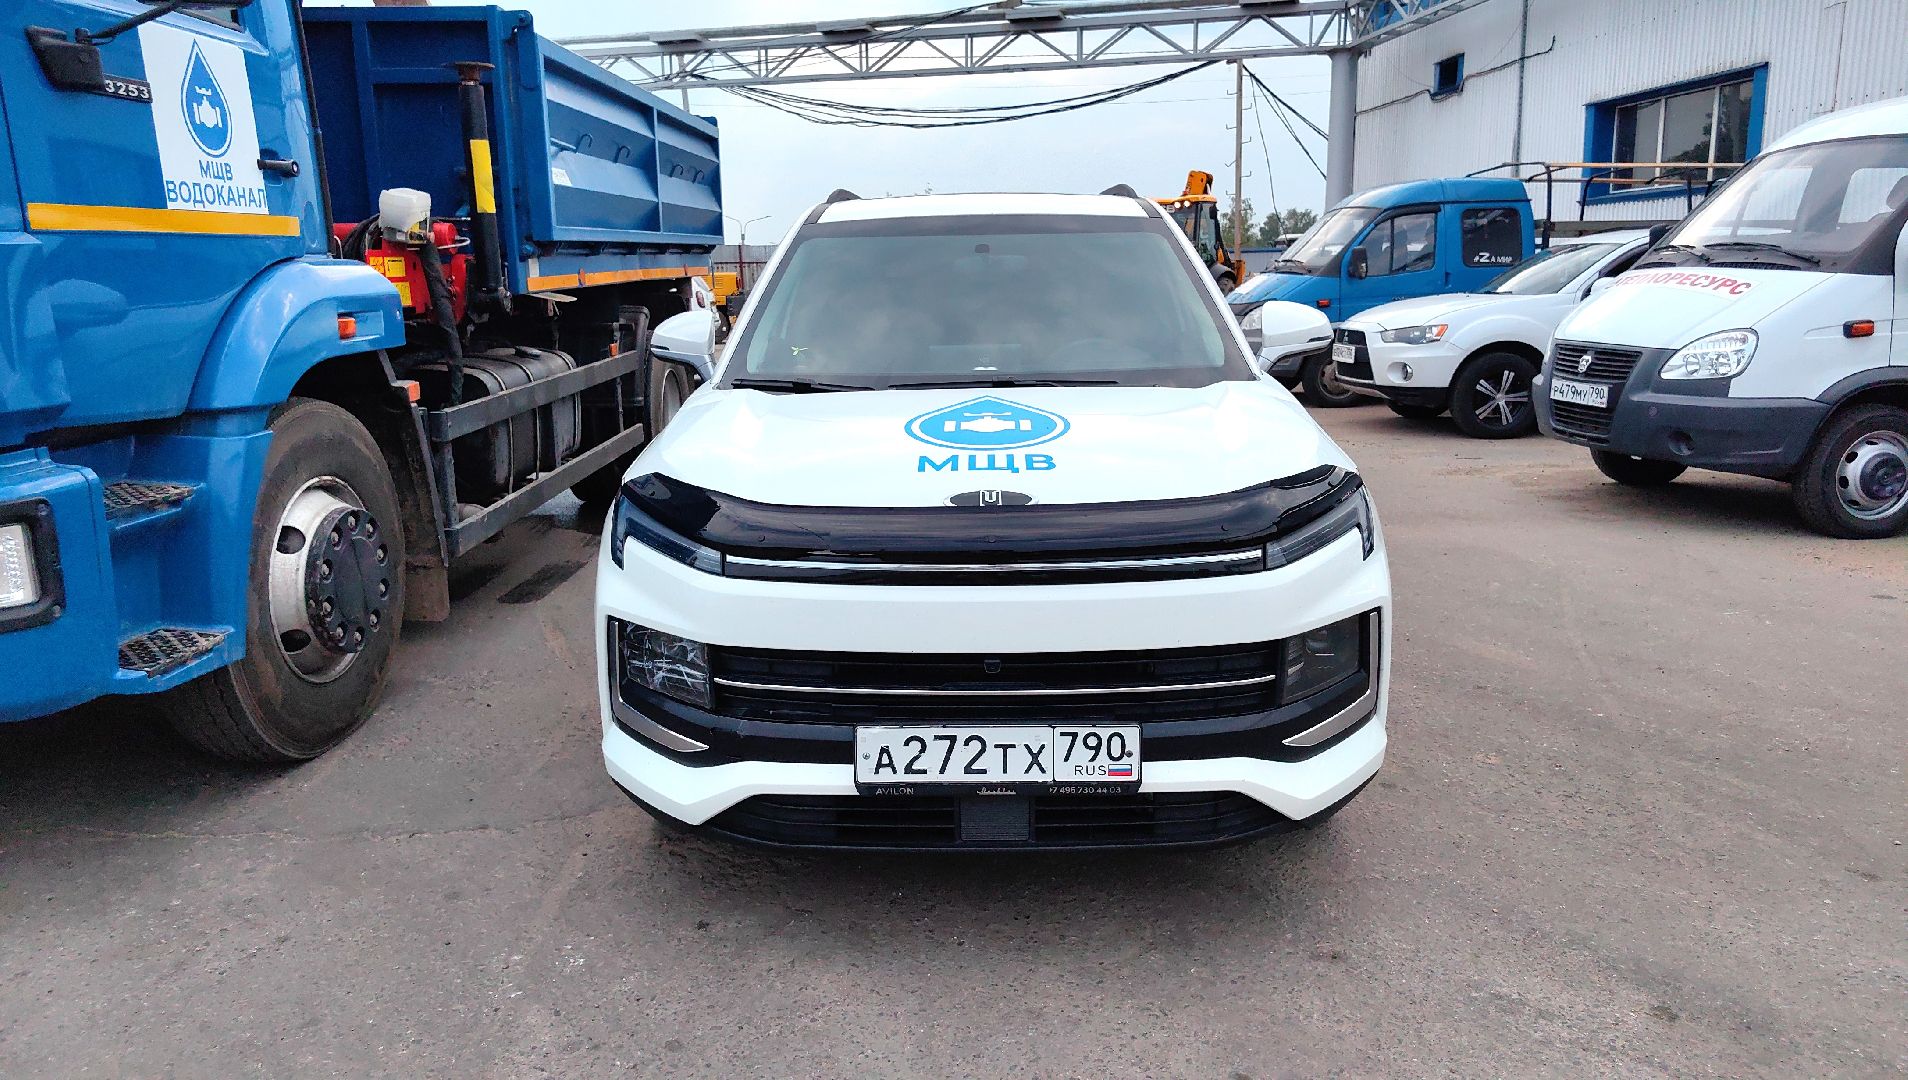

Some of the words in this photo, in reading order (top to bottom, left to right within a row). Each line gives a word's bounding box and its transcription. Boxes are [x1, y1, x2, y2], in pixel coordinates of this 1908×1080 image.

[199, 159, 233, 183] МЩВ
[165, 180, 267, 208] ВОДОКАНАЛ
[917, 453, 1057, 473] МЩВ
[873, 734, 1048, 775] А272ТХ
[1059, 731, 1127, 763] 790
[1074, 765, 1107, 776] RUS
[875, 786, 915, 796] AVILON
[1077, 786, 1095, 794] 730
